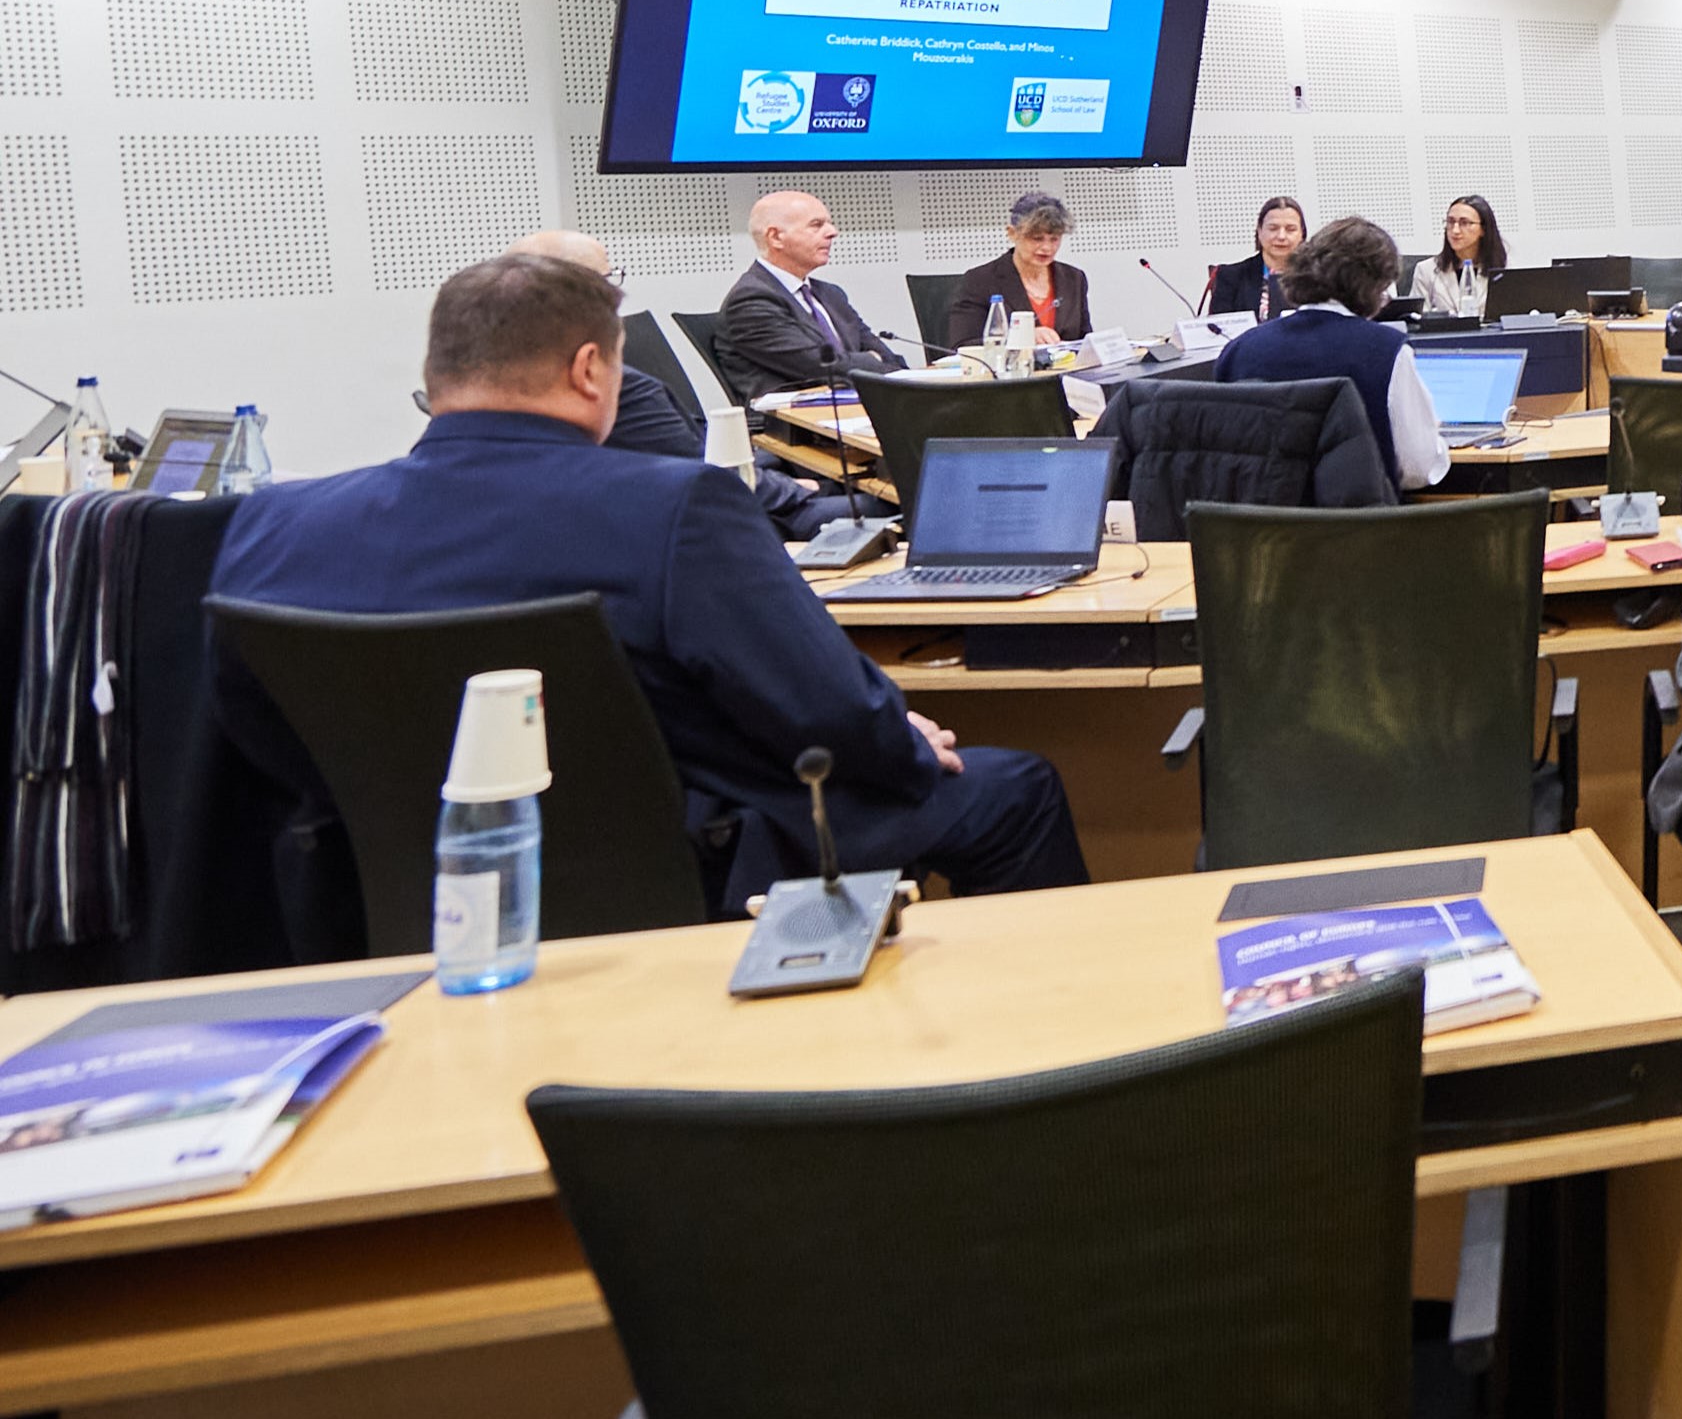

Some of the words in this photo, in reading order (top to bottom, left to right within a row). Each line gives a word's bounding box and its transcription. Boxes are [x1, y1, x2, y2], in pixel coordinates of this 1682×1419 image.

[826, 33, 878, 46] Catherine
[880, 36, 923, 50] Briddick,
[925, 38, 965, 52] Cathryn
[1009, 42, 1026, 52] and
[1027, 43, 1055, 53] Minos
[1018, 94, 1043, 104] UCD
[812, 117, 867, 129] OXFORD
